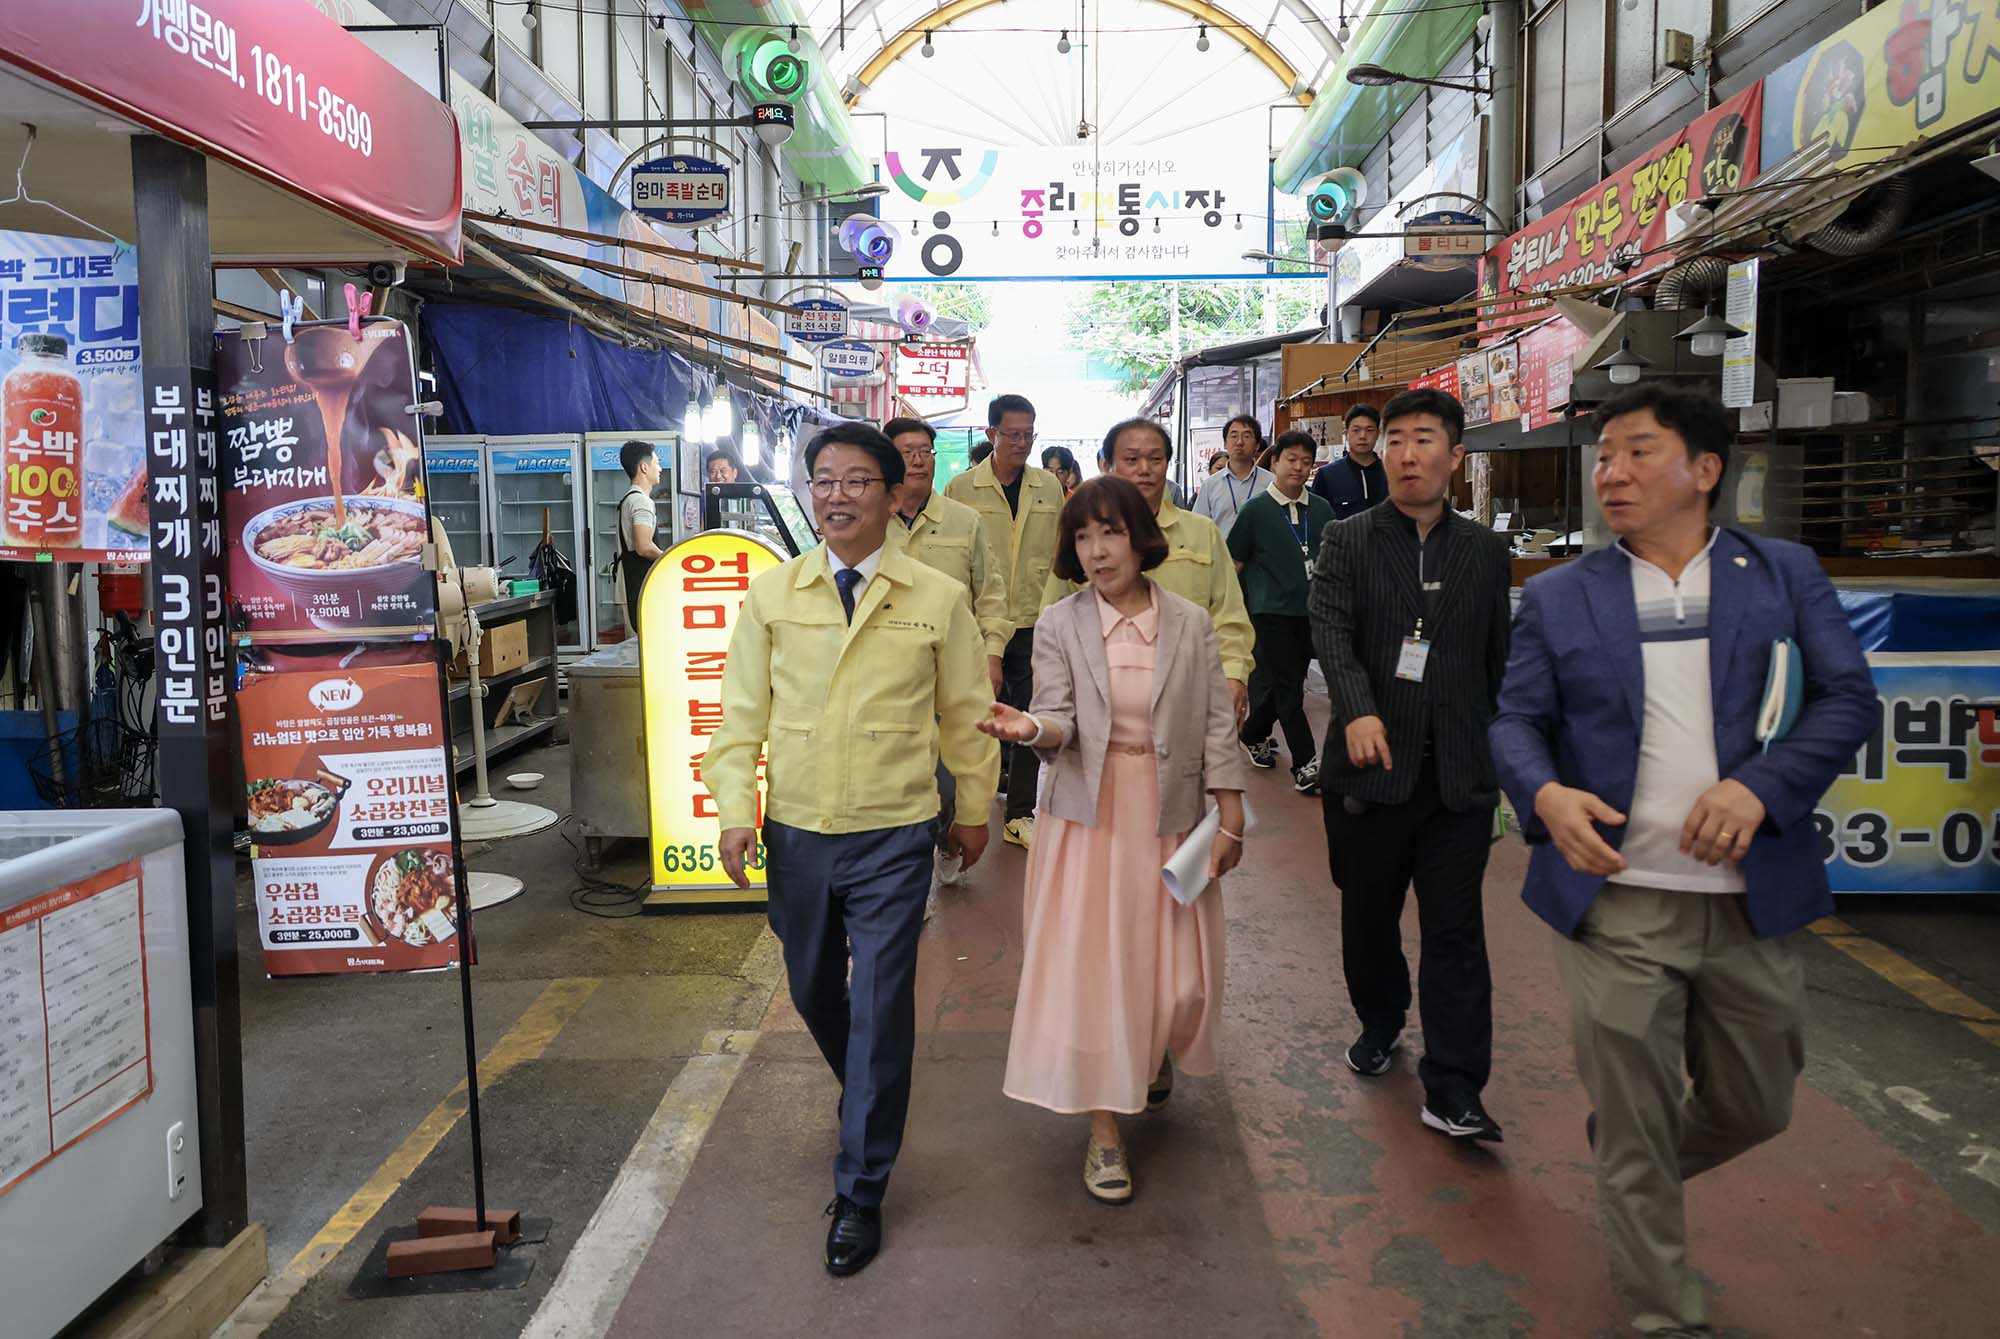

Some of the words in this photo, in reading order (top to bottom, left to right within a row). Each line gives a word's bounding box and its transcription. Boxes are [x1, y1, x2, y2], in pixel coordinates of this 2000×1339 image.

[251, 45, 373, 157] 1811-8599
[504, 134, 564, 230] 순대
[636, 182, 724, 200] 엄마족발순대
[1020, 182, 1226, 238] 중리전통시장
[1574, 185, 1624, 257] 만두
[1124, 245, 1191, 260] 감사합니다
[33, 256, 114, 281] 그대로
[829, 353, 868, 365] 알뜰의류
[911, 361, 950, 386] 오떡
[8, 428, 78, 464] 수박
[227, 417, 299, 463] 짬뽕
[7, 464, 79, 497] 100%
[151, 386, 190, 559] 부대찌개
[196, 387, 221, 559] 부대찌개
[234, 466, 327, 495] 부대찌개
[8, 498, 78, 533] 주스
[312, 593, 340, 605] 3인분
[160, 574, 200, 724] 3인분
[204, 574, 228, 721] 3인분
[320, 688, 351, 701] NEW
[252, 731, 302, 746] 리뉴얼된
[304, 729, 339, 744] 맛으로
[341, 728, 365, 741] 입안
[367, 726, 391, 739] 가득
[393, 723, 433, 737] 행복을!
[367, 774, 445, 797] 오리지널
[350, 799, 448, 822] 소곱창전골
[360, 827, 382, 838] 3인분
[393, 824, 440, 836] 23,900원
[265, 883, 320, 901] 우삼겹
[268, 905, 360, 926] 소곱창전골
[276, 931, 300, 941] 3인분
[308, 929, 351, 940] 25,900원
